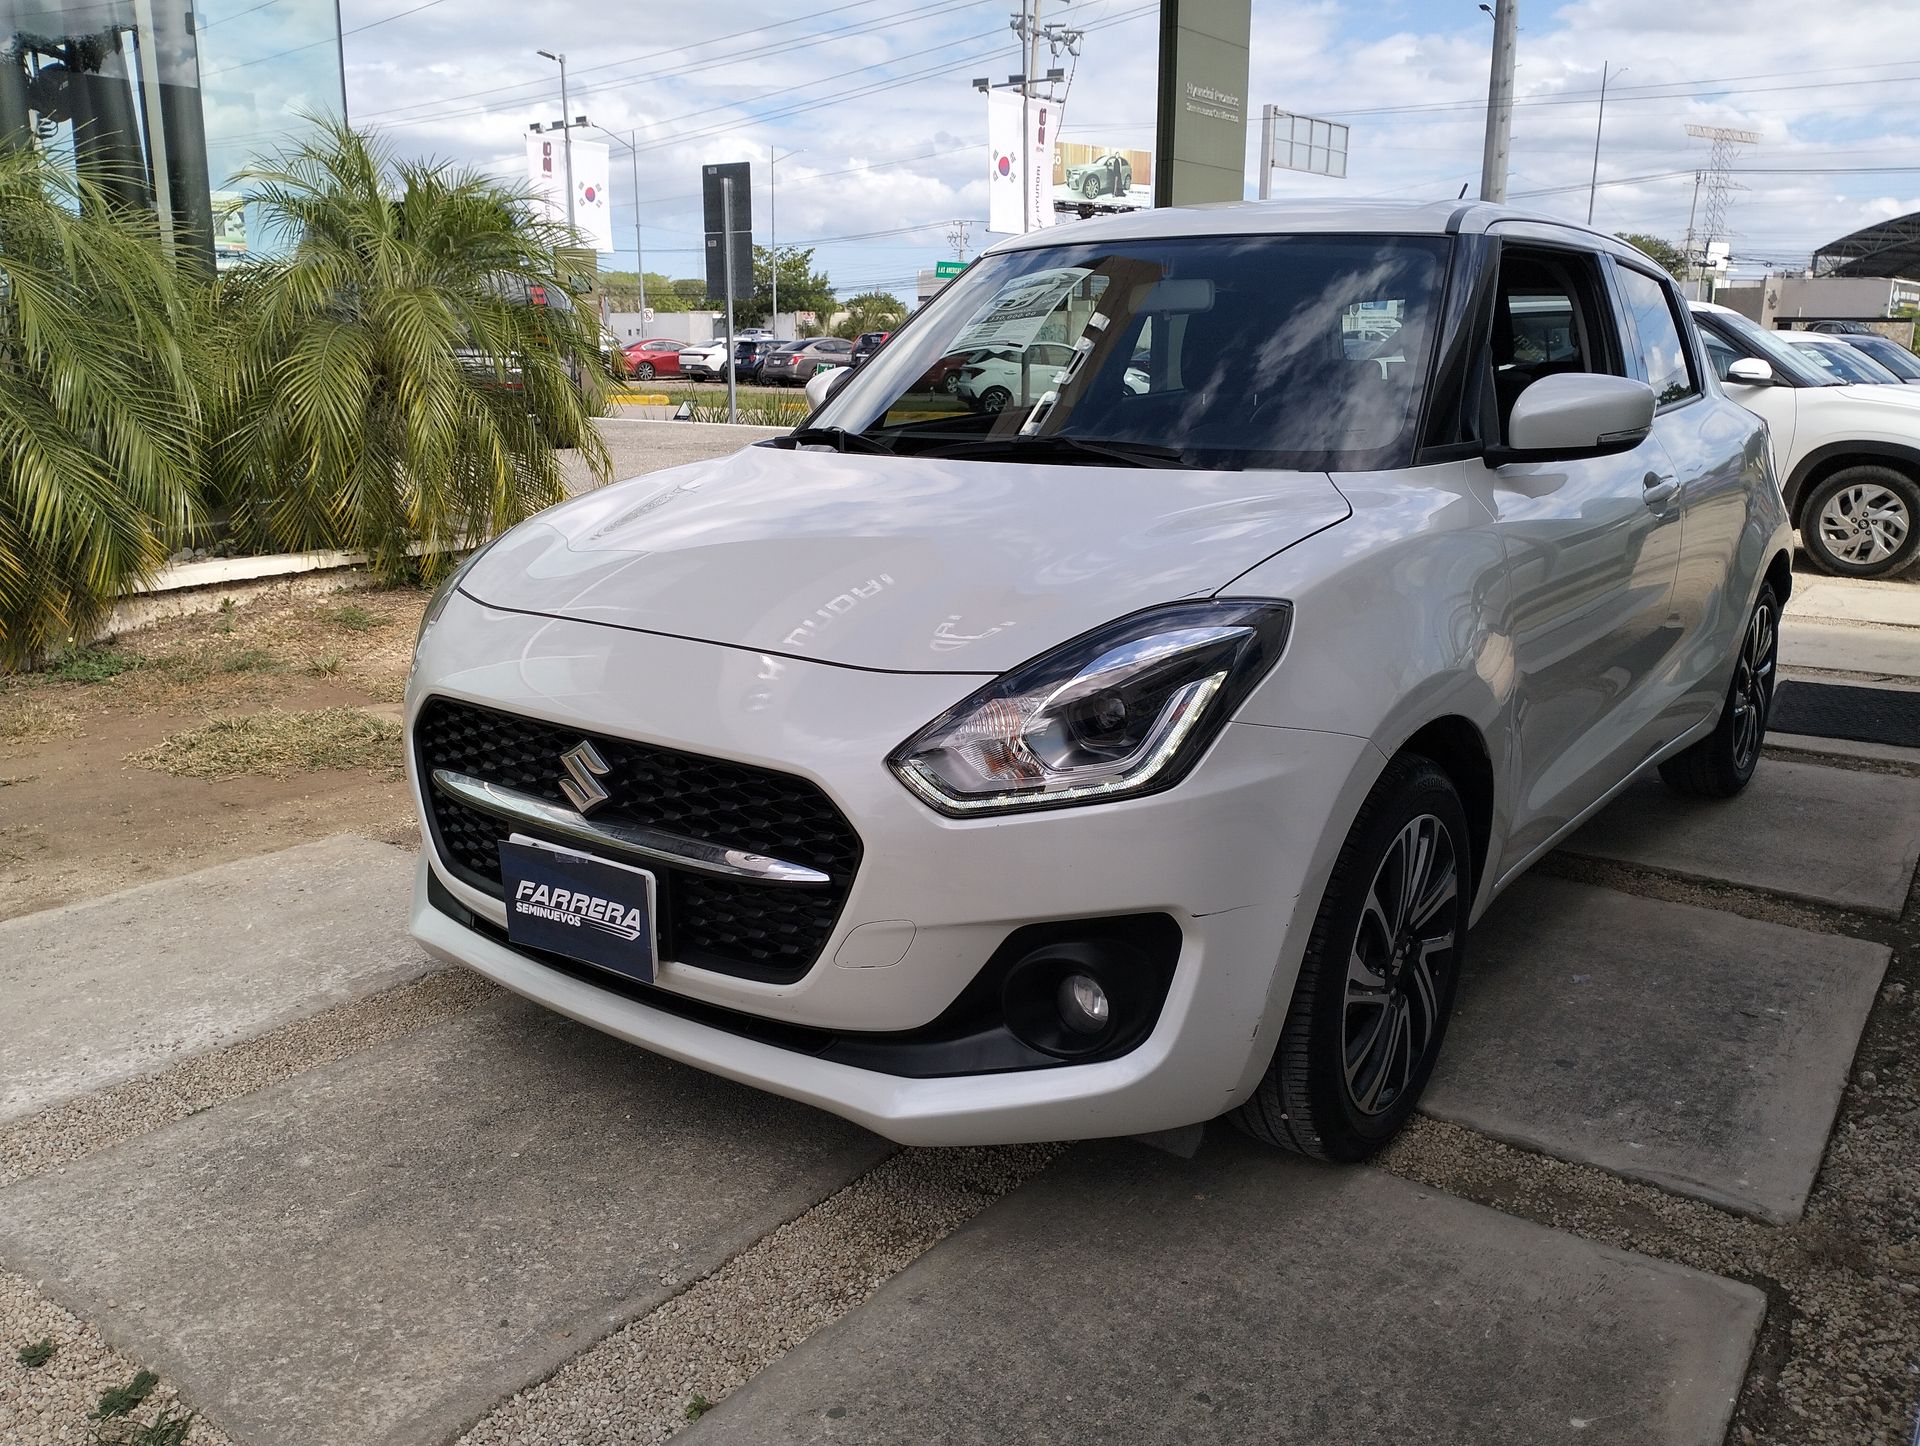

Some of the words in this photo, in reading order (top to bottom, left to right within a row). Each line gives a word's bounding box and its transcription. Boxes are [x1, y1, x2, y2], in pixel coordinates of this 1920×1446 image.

[1032, 165, 1041, 213] HYUNDAI
[515, 880, 641, 931] FARRERA
[516, 902, 581, 927] SEMINUEVOS
